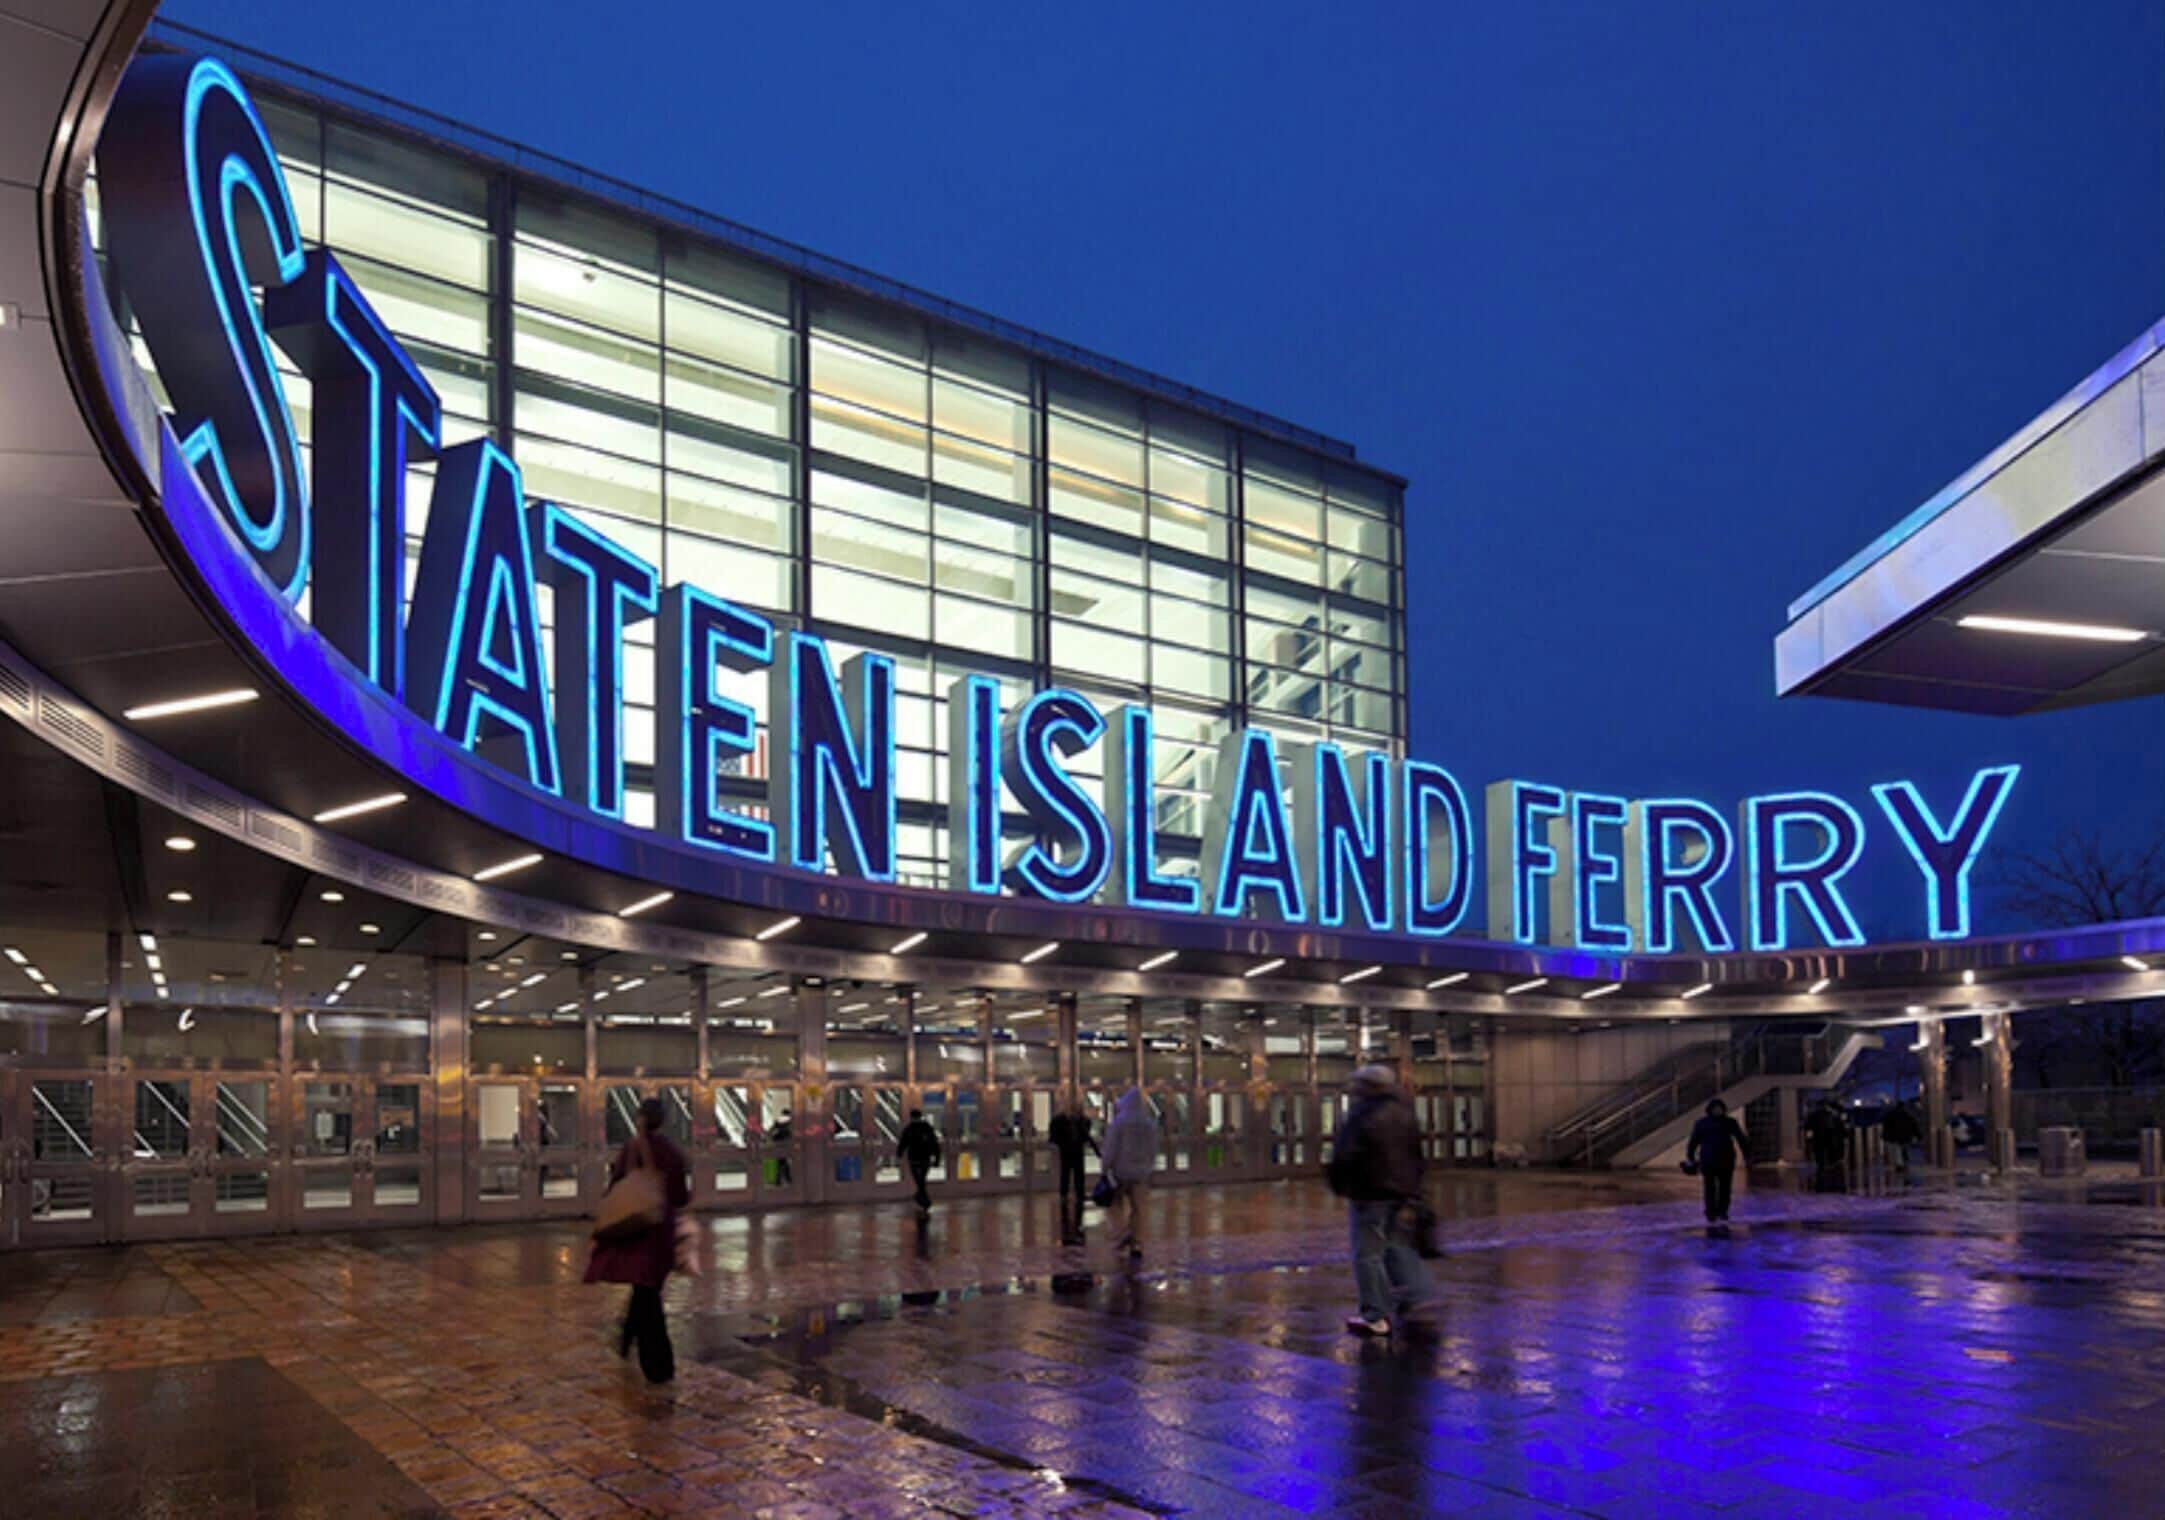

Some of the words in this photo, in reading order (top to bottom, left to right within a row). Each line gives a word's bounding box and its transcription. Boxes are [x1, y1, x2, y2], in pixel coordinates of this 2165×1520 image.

[178, 56, 896, 885] STATEN
[967, 673, 1473, 937] ISLAND
[1512, 763, 2022, 955] FERRY
